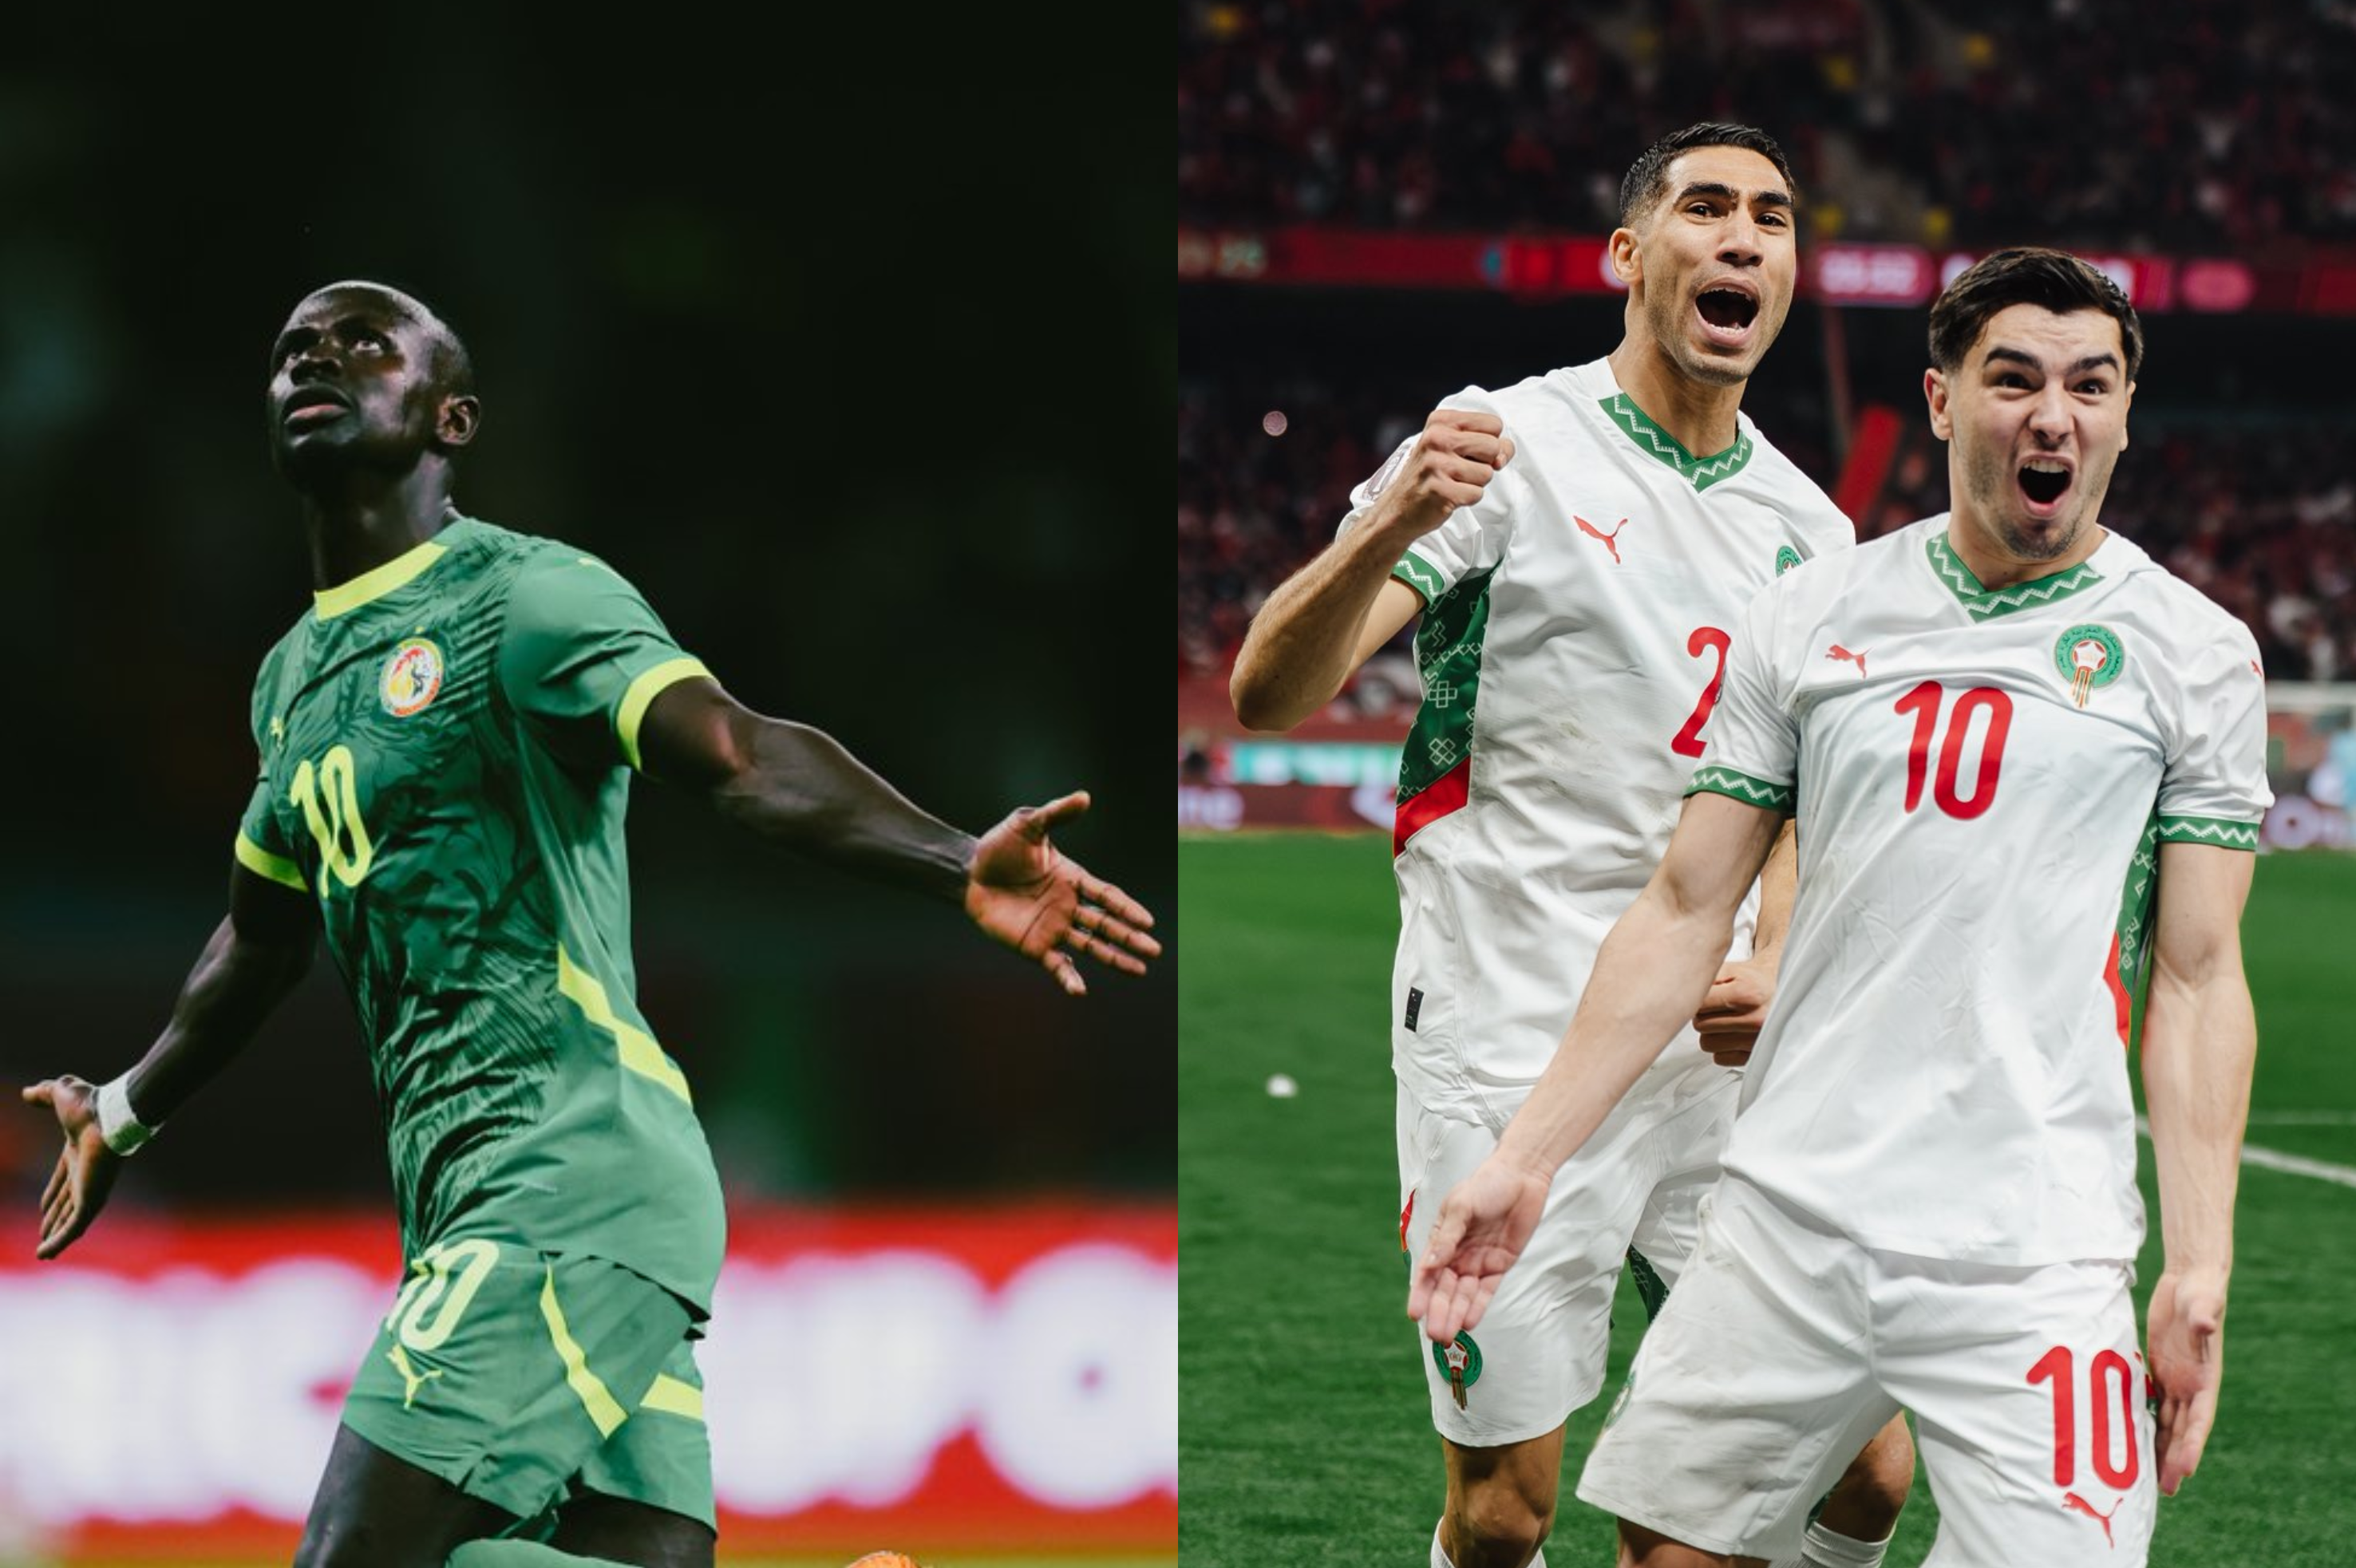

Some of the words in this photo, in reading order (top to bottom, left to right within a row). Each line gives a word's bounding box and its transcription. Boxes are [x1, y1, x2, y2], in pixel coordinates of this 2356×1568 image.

[1671, 626, 1732, 759] 2
[1894, 681, 2014, 821] 10
[291, 745, 372, 899] 10
[385, 1238, 500, 1351] 10
[2026, 1345, 2140, 1491] 10
